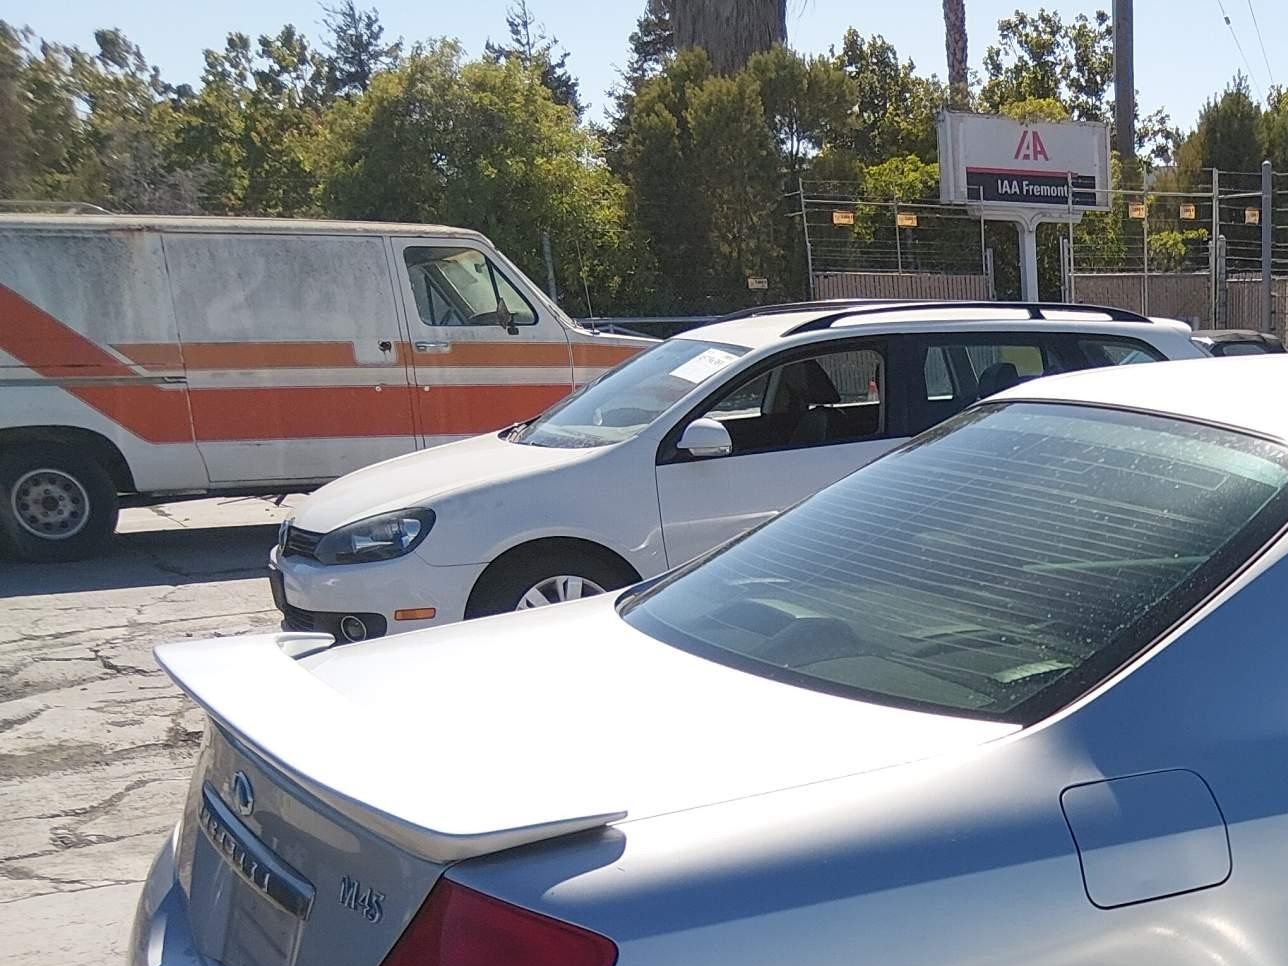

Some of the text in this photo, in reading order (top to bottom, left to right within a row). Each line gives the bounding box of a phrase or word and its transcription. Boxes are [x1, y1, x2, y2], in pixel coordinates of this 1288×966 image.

[997, 179, 1069, 198] IAA Fremont
[338, 874, 385, 924] M45
